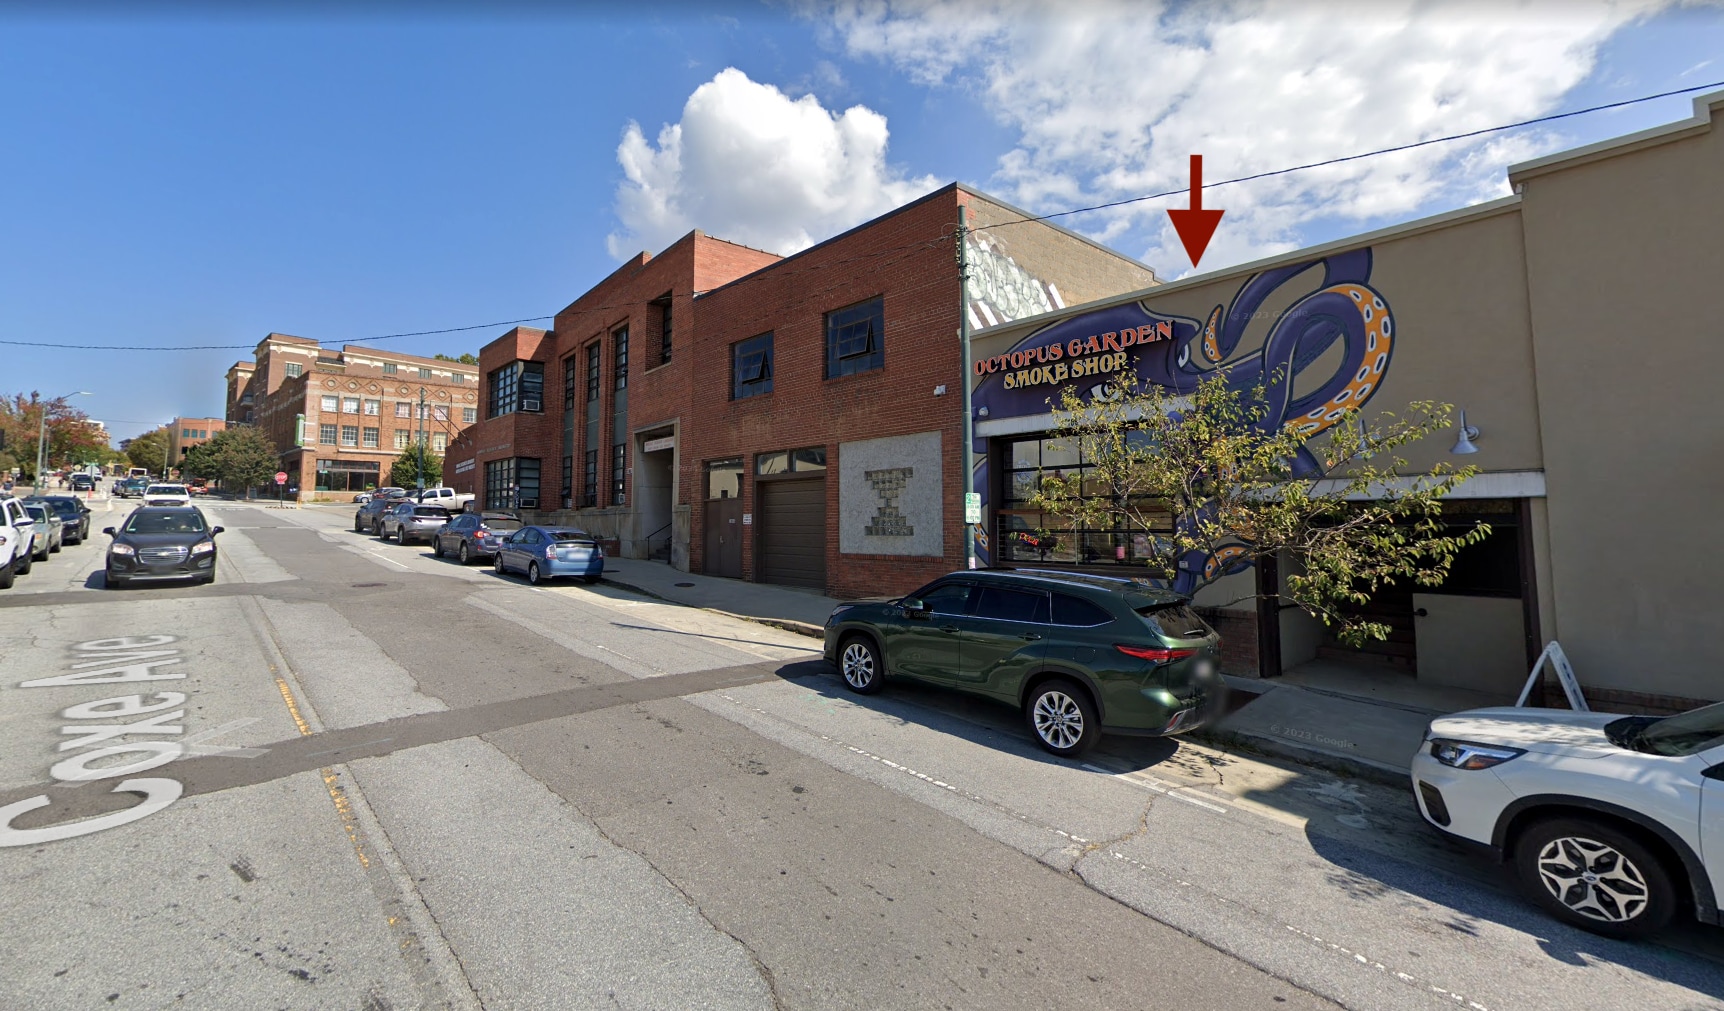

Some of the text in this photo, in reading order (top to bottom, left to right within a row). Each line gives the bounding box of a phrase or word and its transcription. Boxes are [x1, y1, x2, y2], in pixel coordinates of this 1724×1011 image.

[973, 319, 1173, 376] OCTOPUS GARDEN
[1003, 352, 1127, 390] SMOKE SHOP
